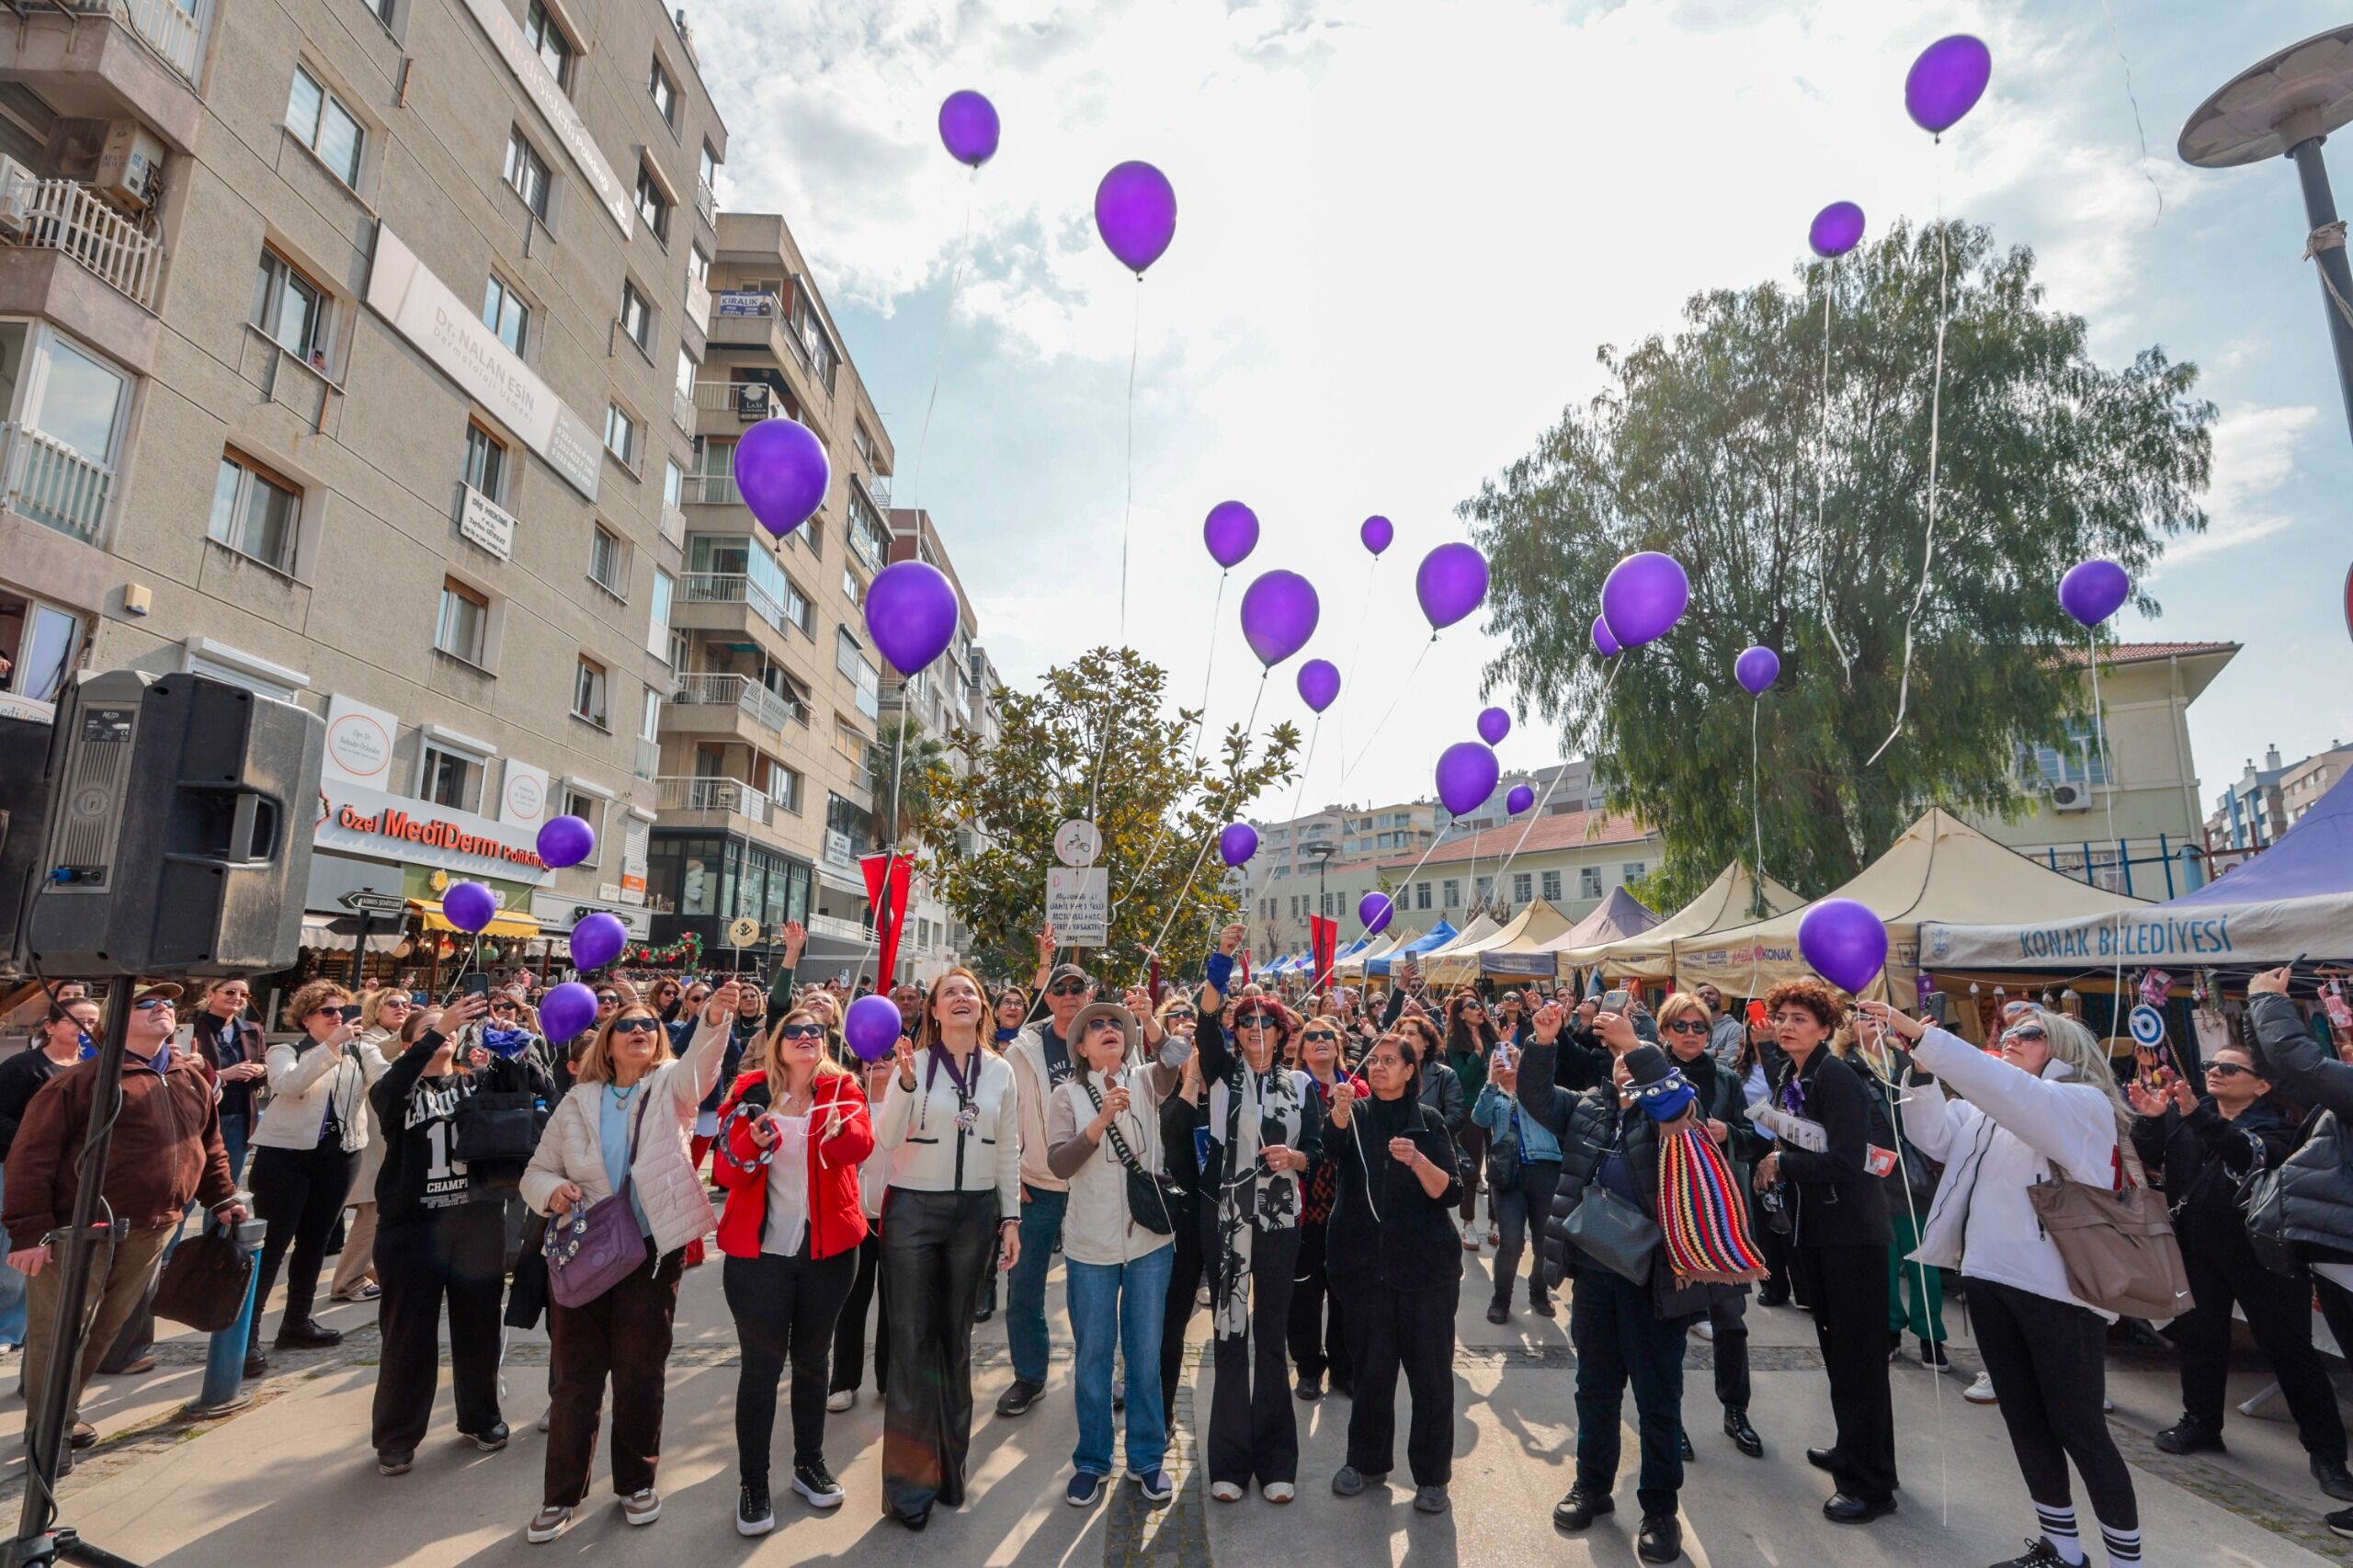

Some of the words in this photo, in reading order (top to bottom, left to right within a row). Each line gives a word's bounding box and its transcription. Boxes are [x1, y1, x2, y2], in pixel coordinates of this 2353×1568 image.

[722, 296, 758, 306] KİRALIK
[435, 306, 456, 338] Dr.
[458, 328, 506, 384] NALAN
[507, 376, 535, 411] ESİN
[339, 803, 380, 834] Özel
[382, 808, 501, 858] MediDerm
[2019, 926, 2090, 959] KONAK
[2097, 914, 2234, 957] BELEDİYESİ
[1762, 948, 1793, 961] KONAK
[1049, 1061, 1067, 1074] AMI
